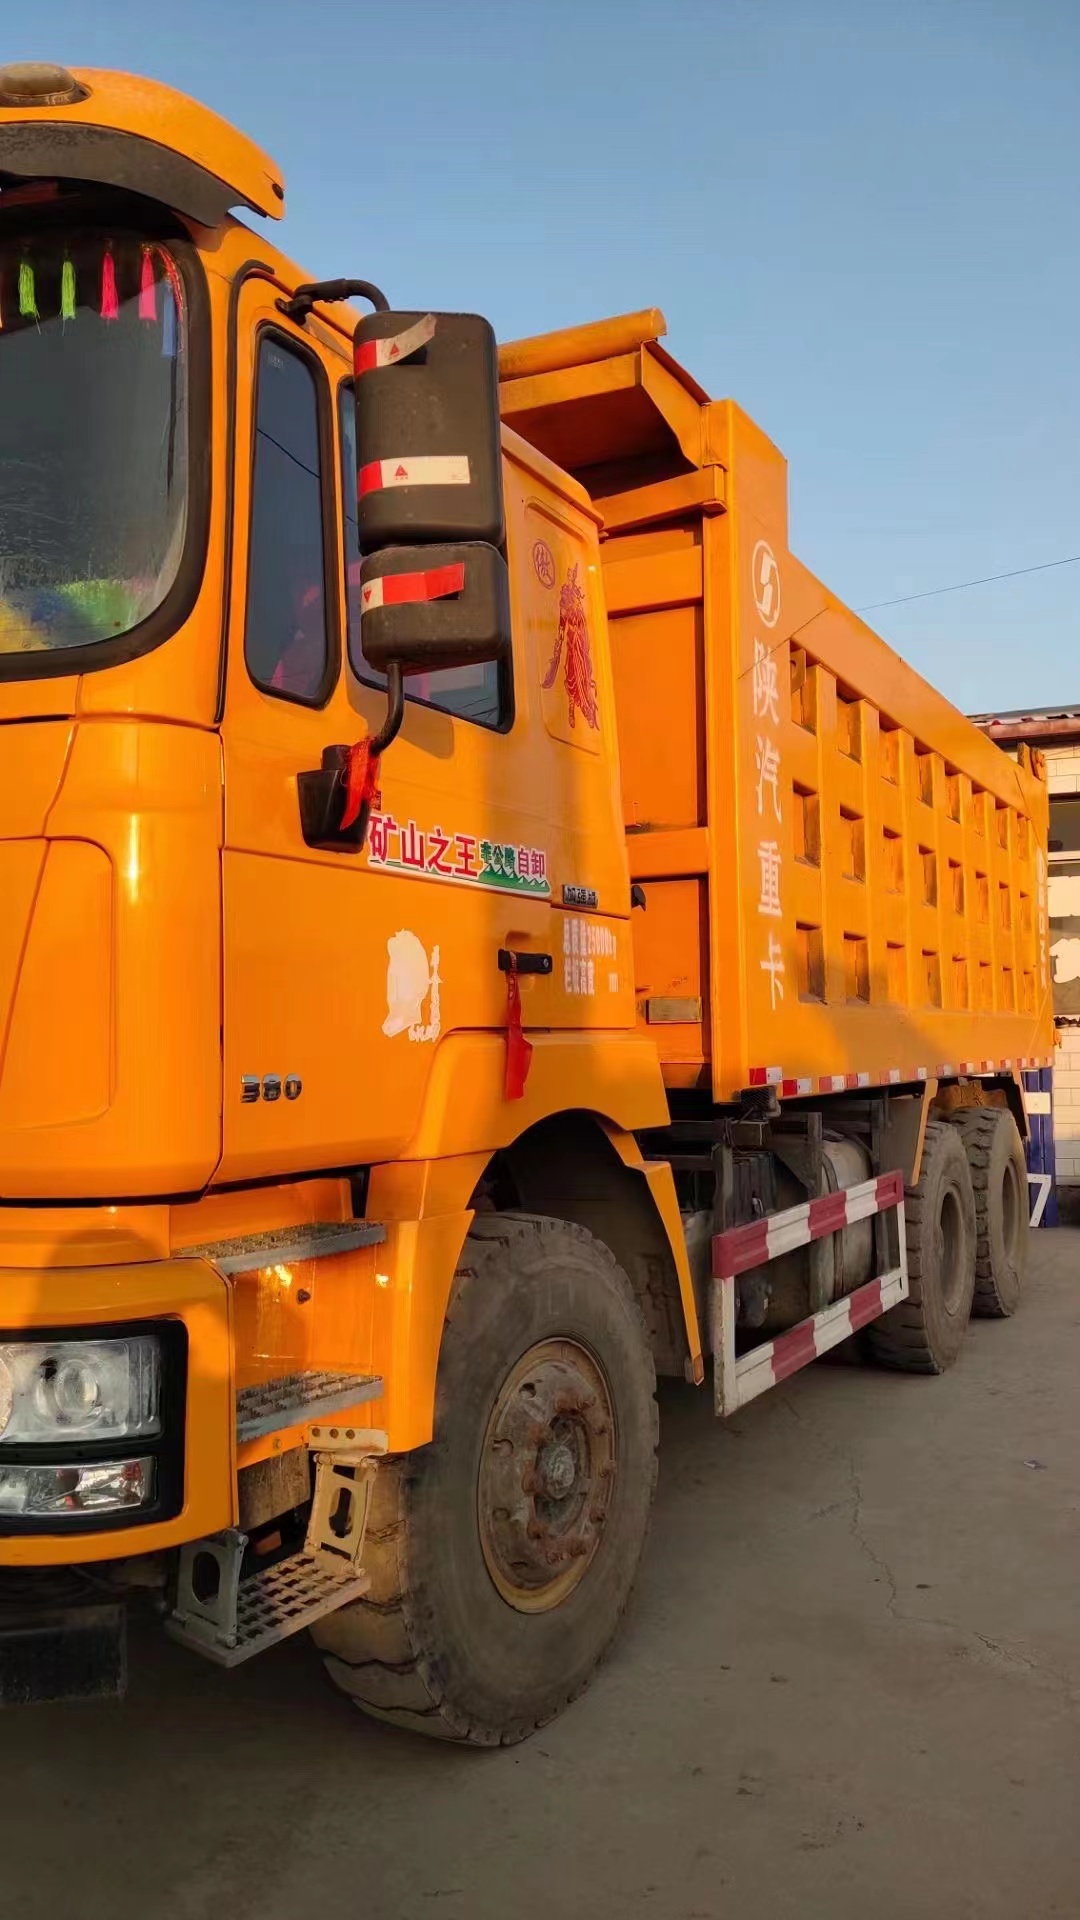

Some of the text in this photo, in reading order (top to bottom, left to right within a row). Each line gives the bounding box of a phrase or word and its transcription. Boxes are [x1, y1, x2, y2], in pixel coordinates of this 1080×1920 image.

[368, 815, 478, 877] 矿山之王
[752, 636, 786, 1011] 陕汽重卡
[241, 1073, 302, 1103] 380
